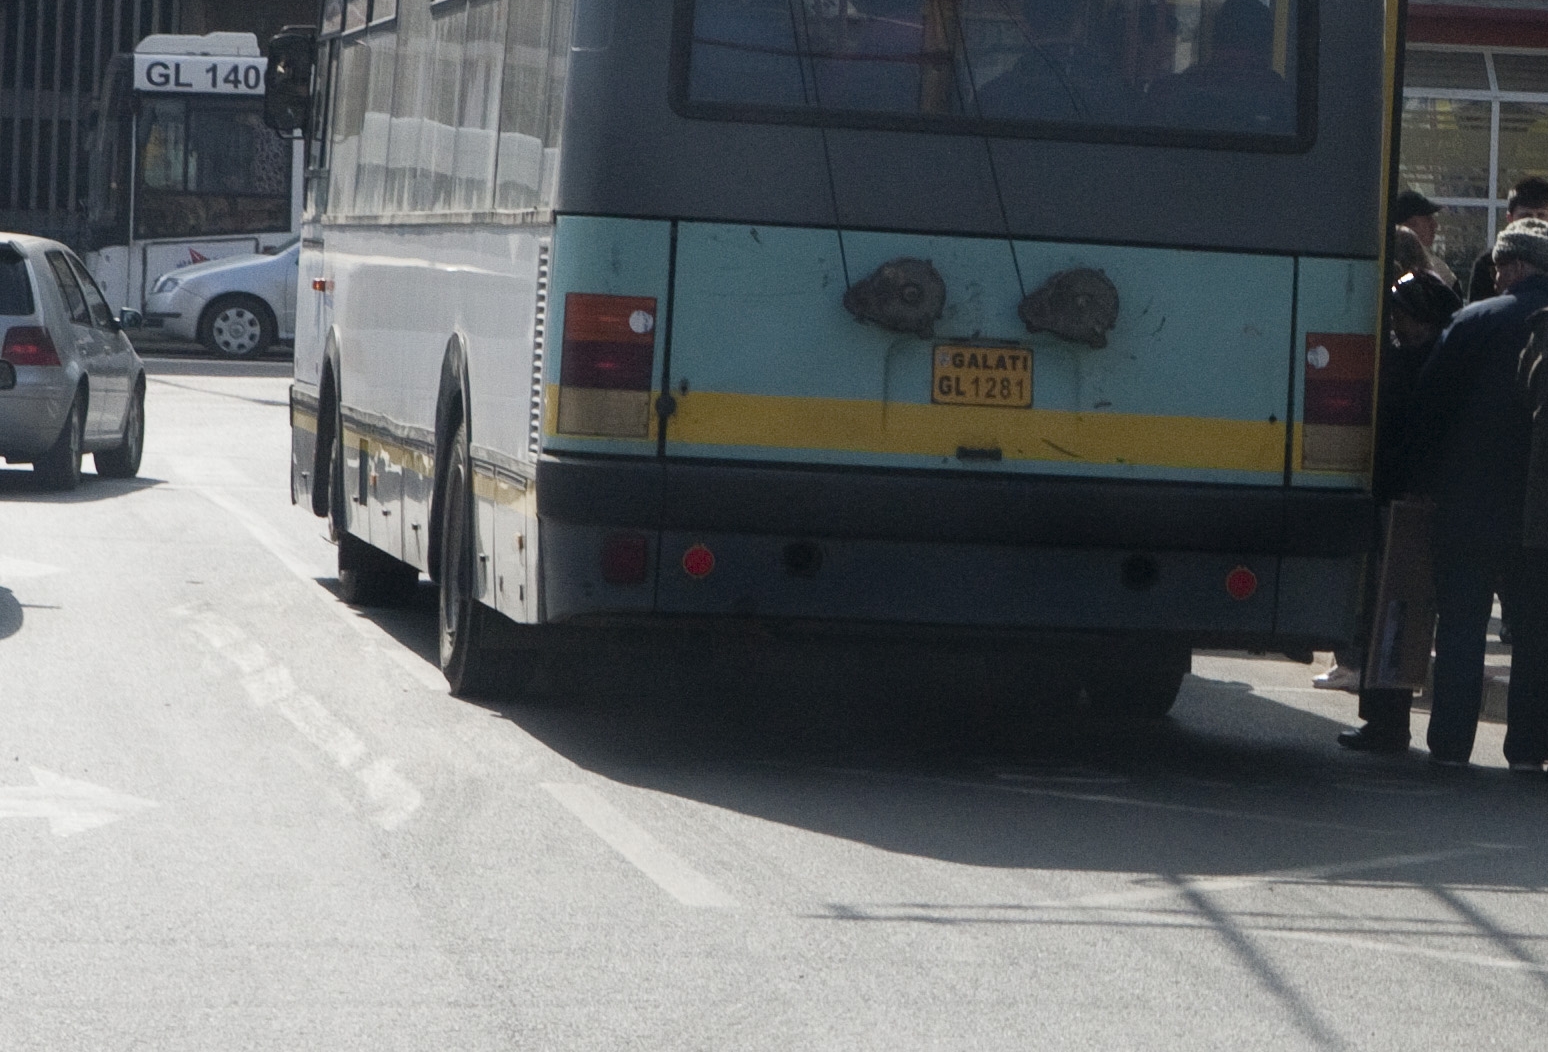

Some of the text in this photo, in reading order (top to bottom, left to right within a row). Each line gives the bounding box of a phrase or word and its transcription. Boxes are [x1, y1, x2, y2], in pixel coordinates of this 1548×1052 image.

[146, 61, 261, 90] GL 140
[952, 352, 1029, 372] GALATI
